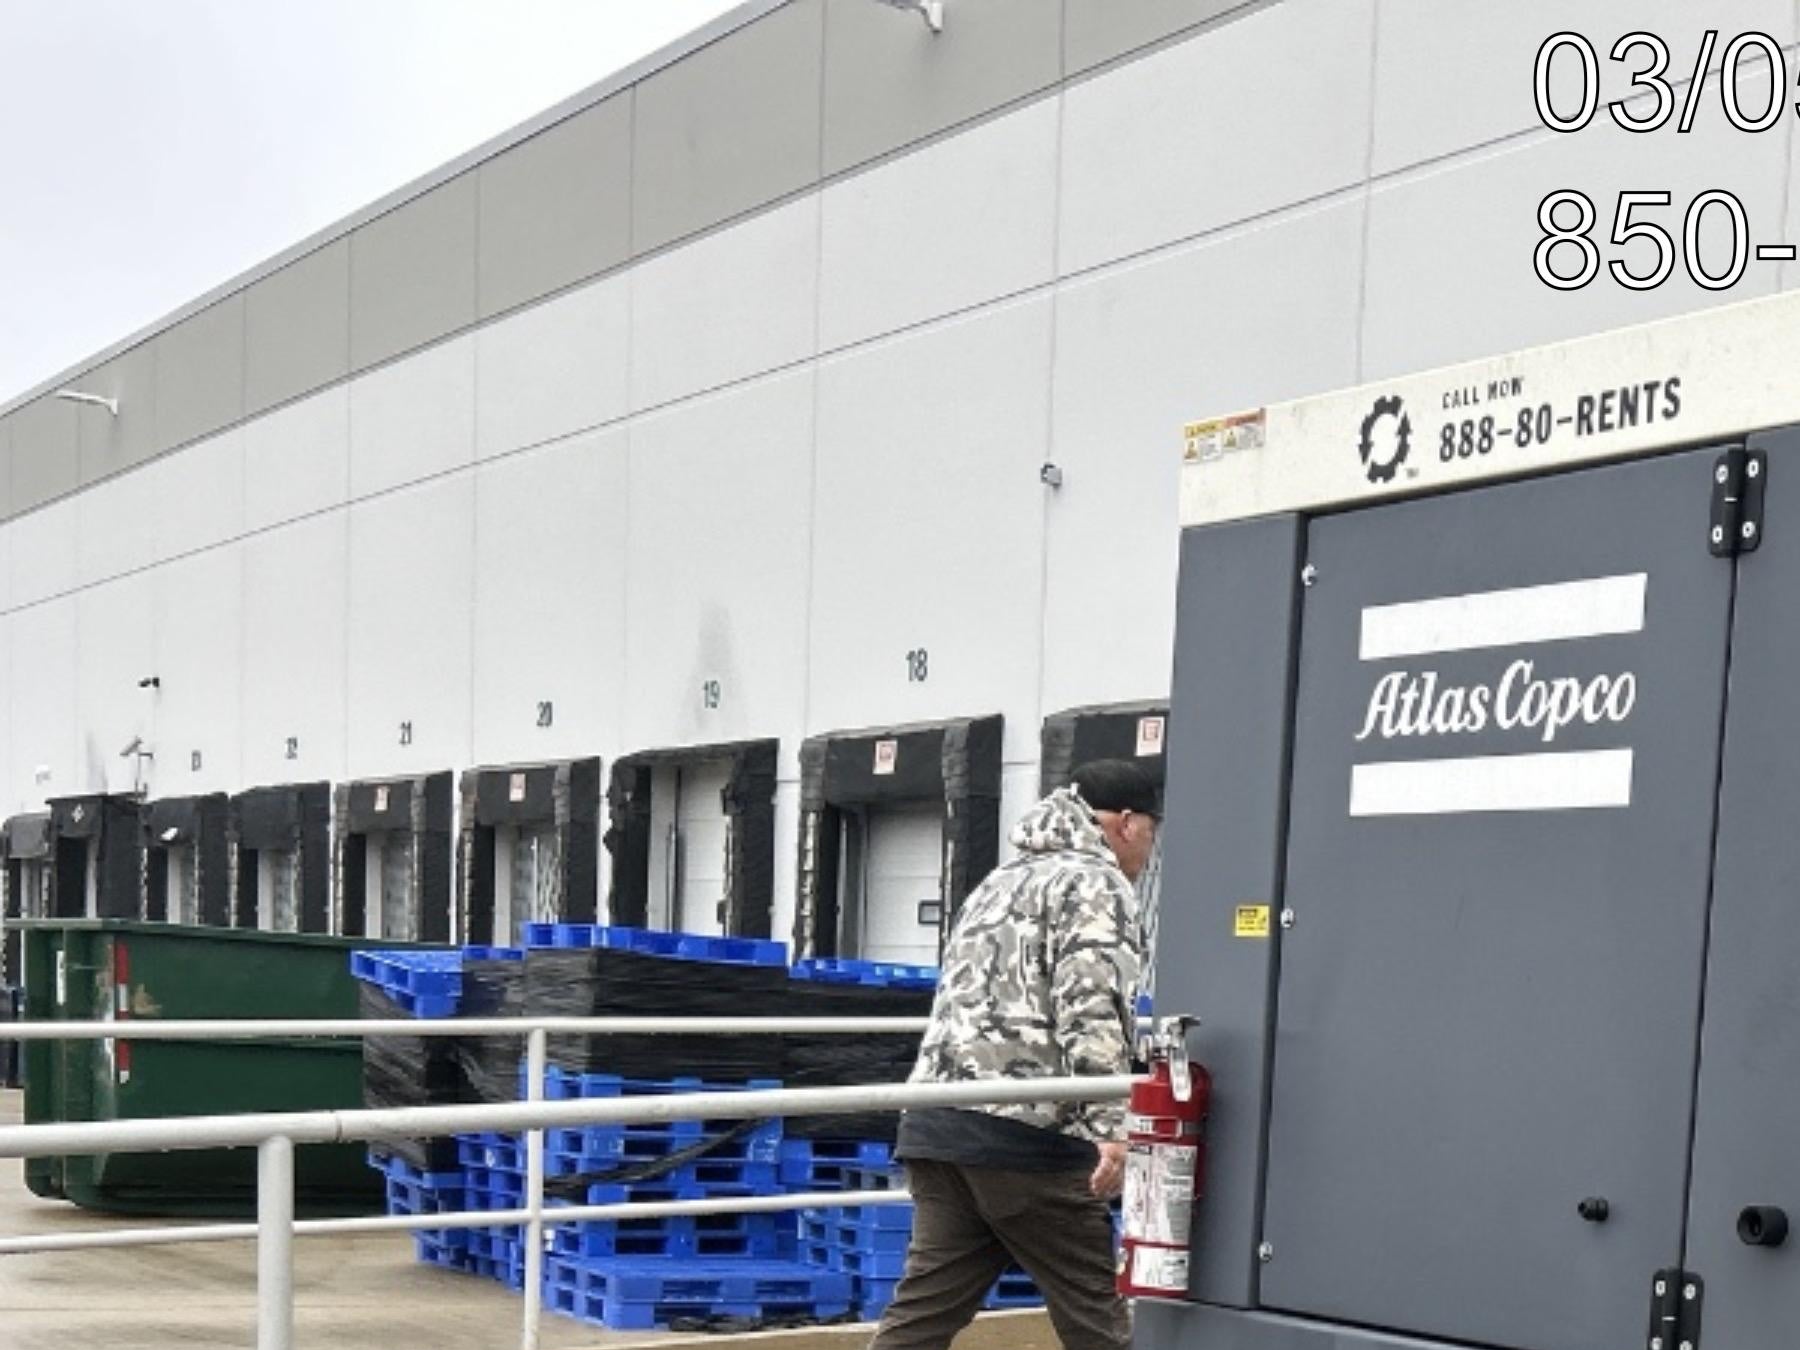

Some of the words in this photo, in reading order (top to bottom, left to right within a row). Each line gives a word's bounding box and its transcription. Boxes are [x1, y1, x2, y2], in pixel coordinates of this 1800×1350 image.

[1442, 386, 1481, 410] CALL
[1487, 377, 1524, 400] NOW
[1440, 376, 1682, 463] 888-80-RENTS
[905, 648, 928, 682] 18
[702, 680, 721, 709] 19
[1354, 671, 1491, 740] Atlas
[1494, 659, 1637, 742] Copco
